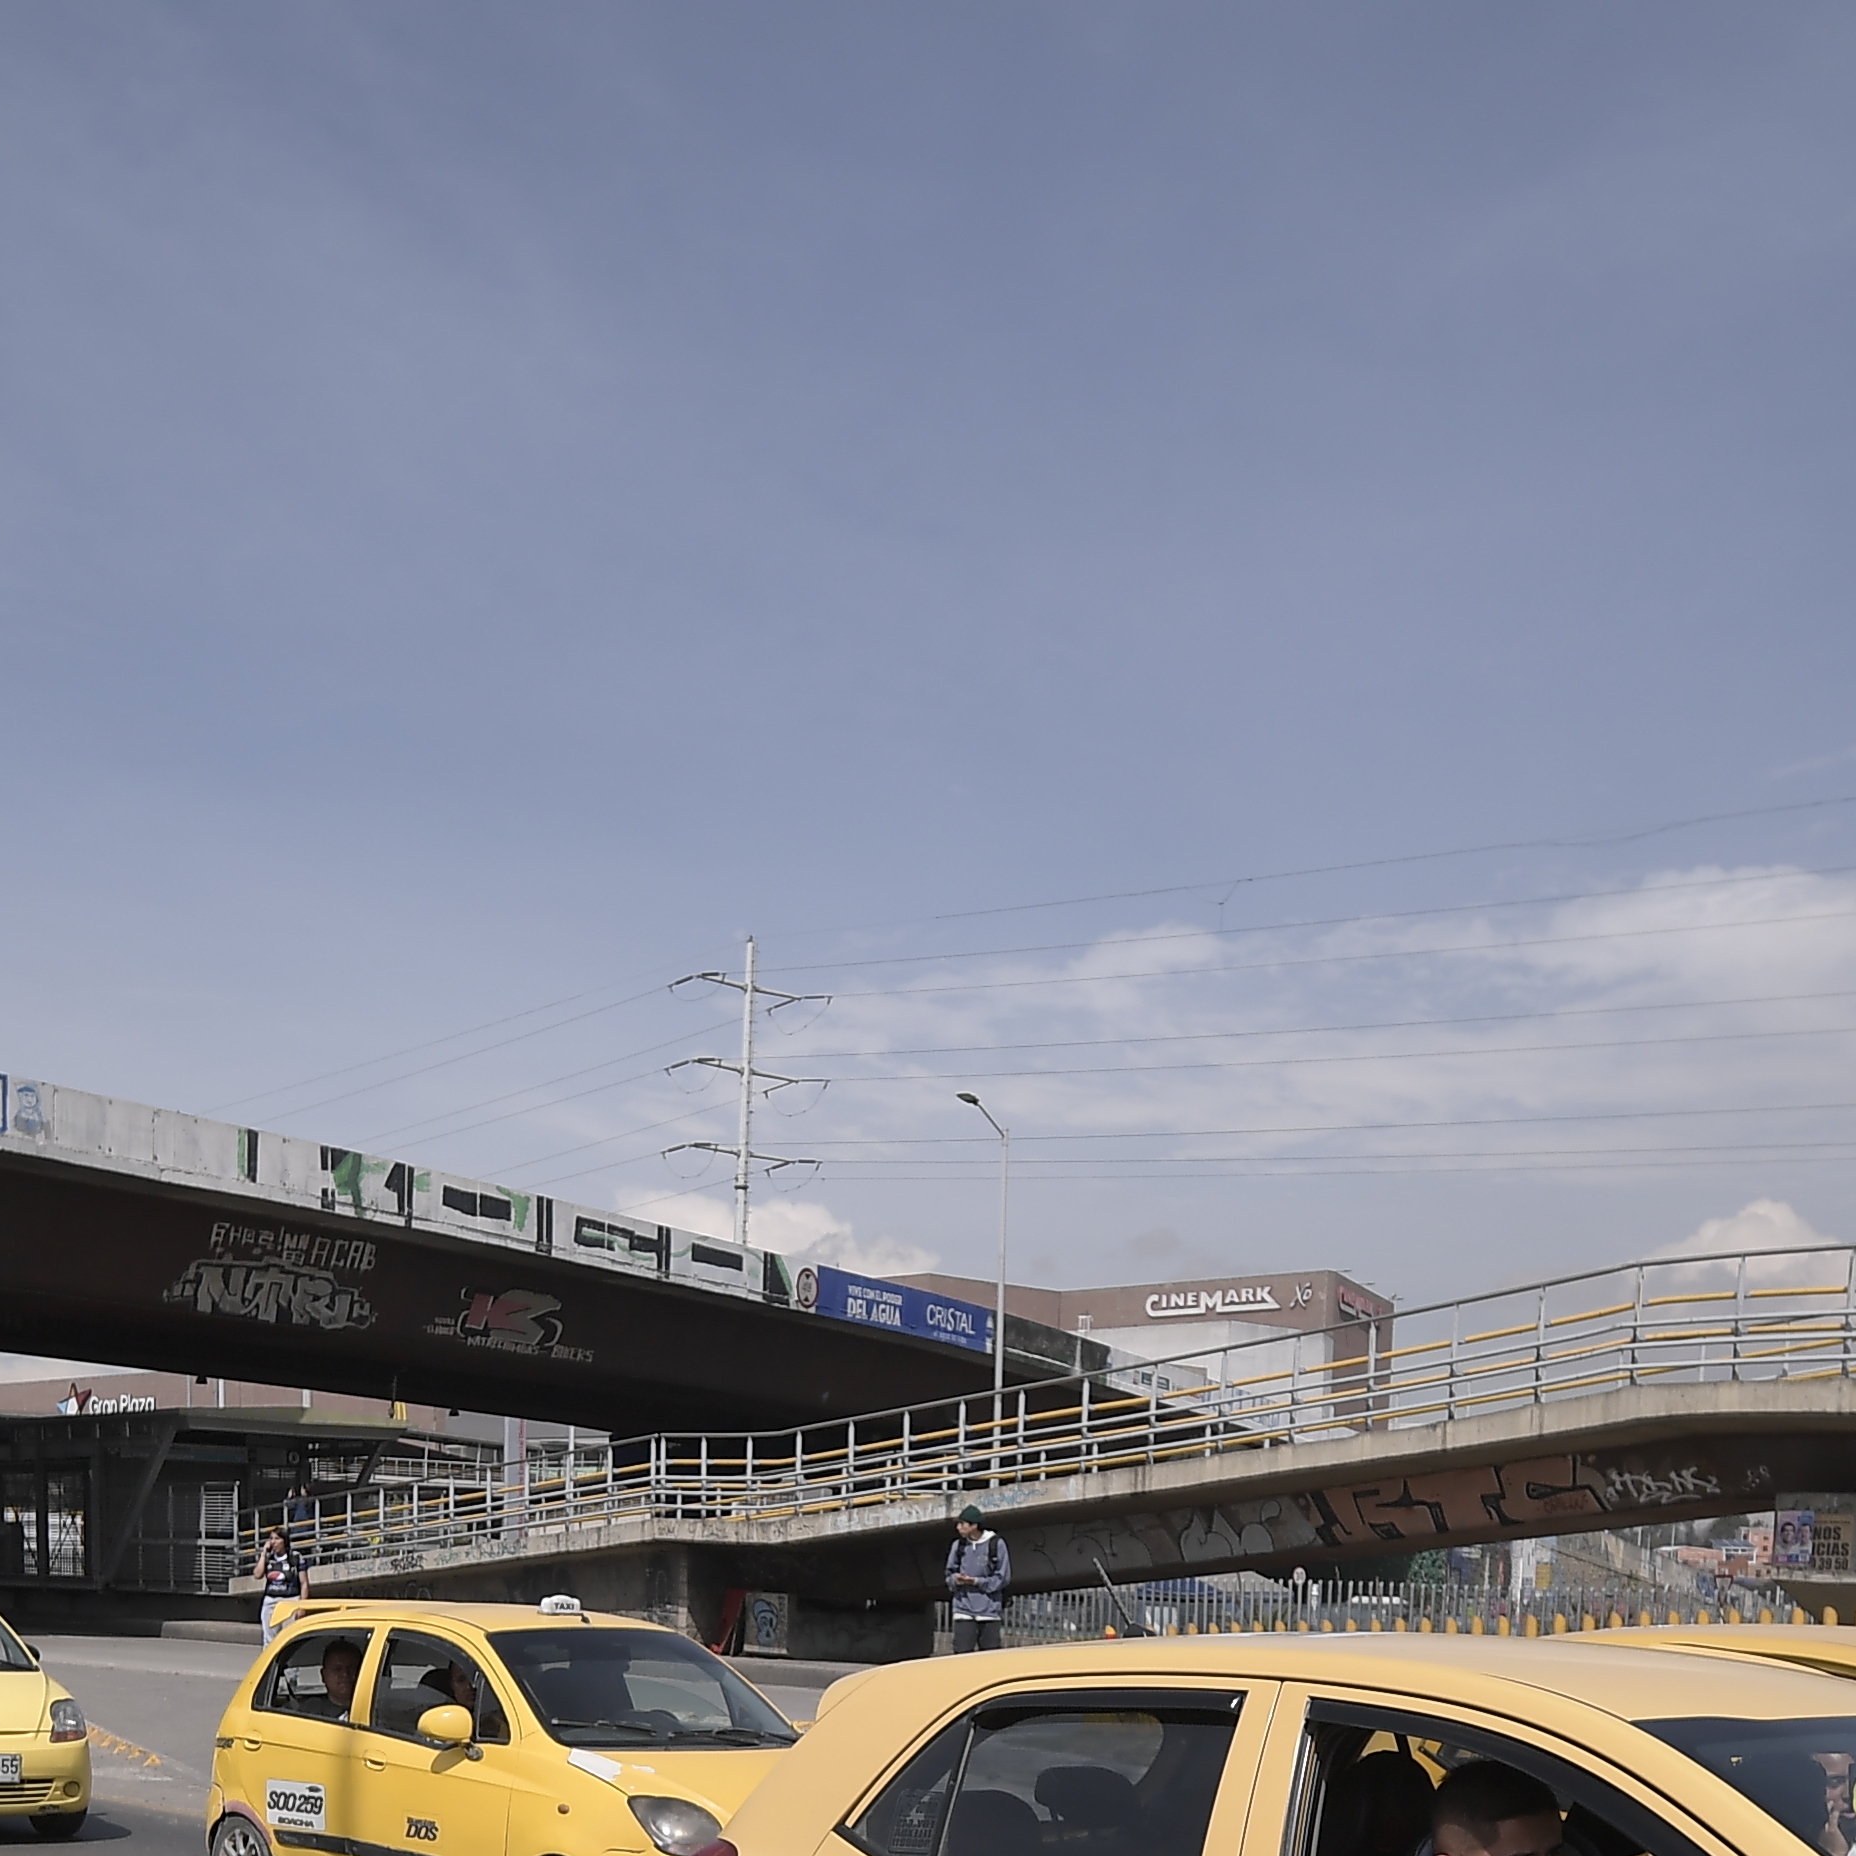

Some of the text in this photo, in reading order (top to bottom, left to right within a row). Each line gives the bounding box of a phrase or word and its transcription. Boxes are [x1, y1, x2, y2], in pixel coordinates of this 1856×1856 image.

[846, 1297, 902, 1327] DEL AGUA
[1144, 1286, 1281, 1318] CINEMARK
[925, 1303, 977, 1335] CRISTAL
[89, 1393, 157, 1415] Gran Plaza
[553, 1601, 575, 1611] TAXI
[405, 1824, 439, 1842] DOS
